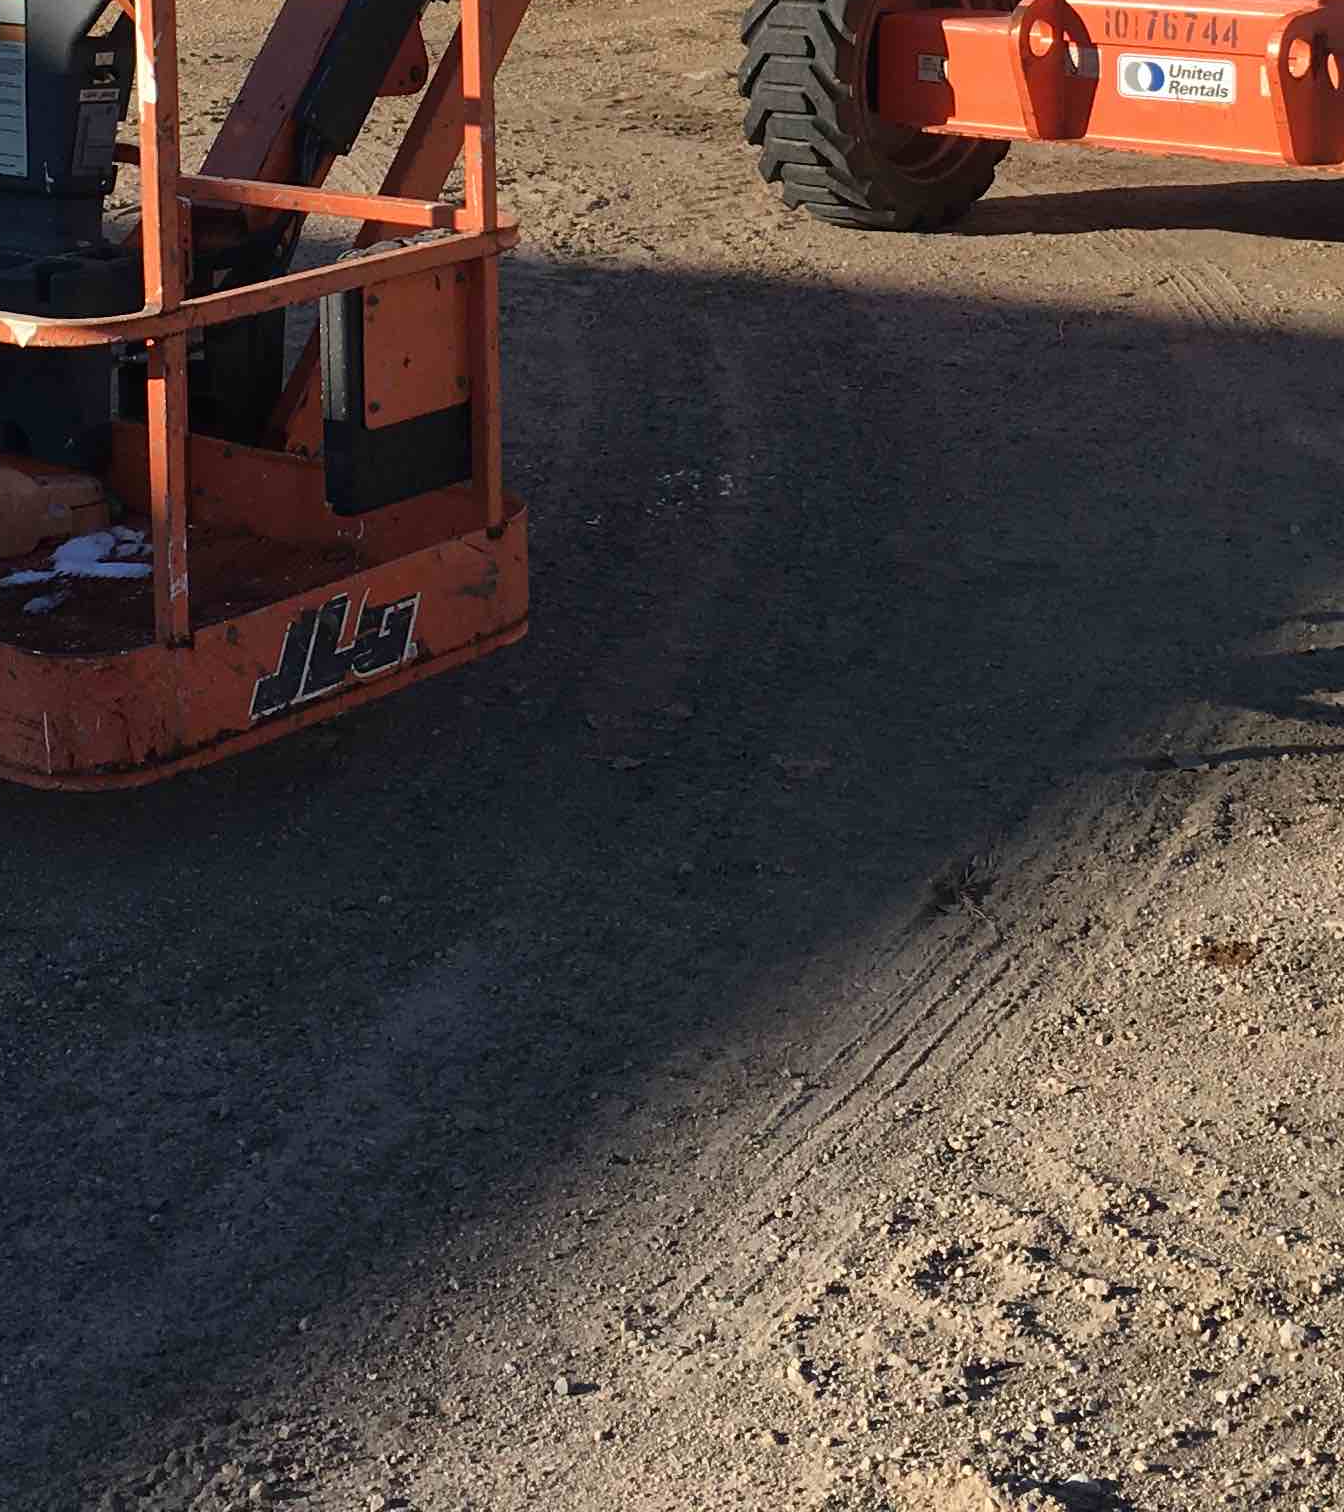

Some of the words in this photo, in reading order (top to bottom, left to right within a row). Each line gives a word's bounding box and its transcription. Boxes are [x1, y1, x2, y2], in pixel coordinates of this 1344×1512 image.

[1168, 64, 1224, 82] United
[1168, 80, 1229, 98] Rentals
[249, 587, 422, 721] JLG
